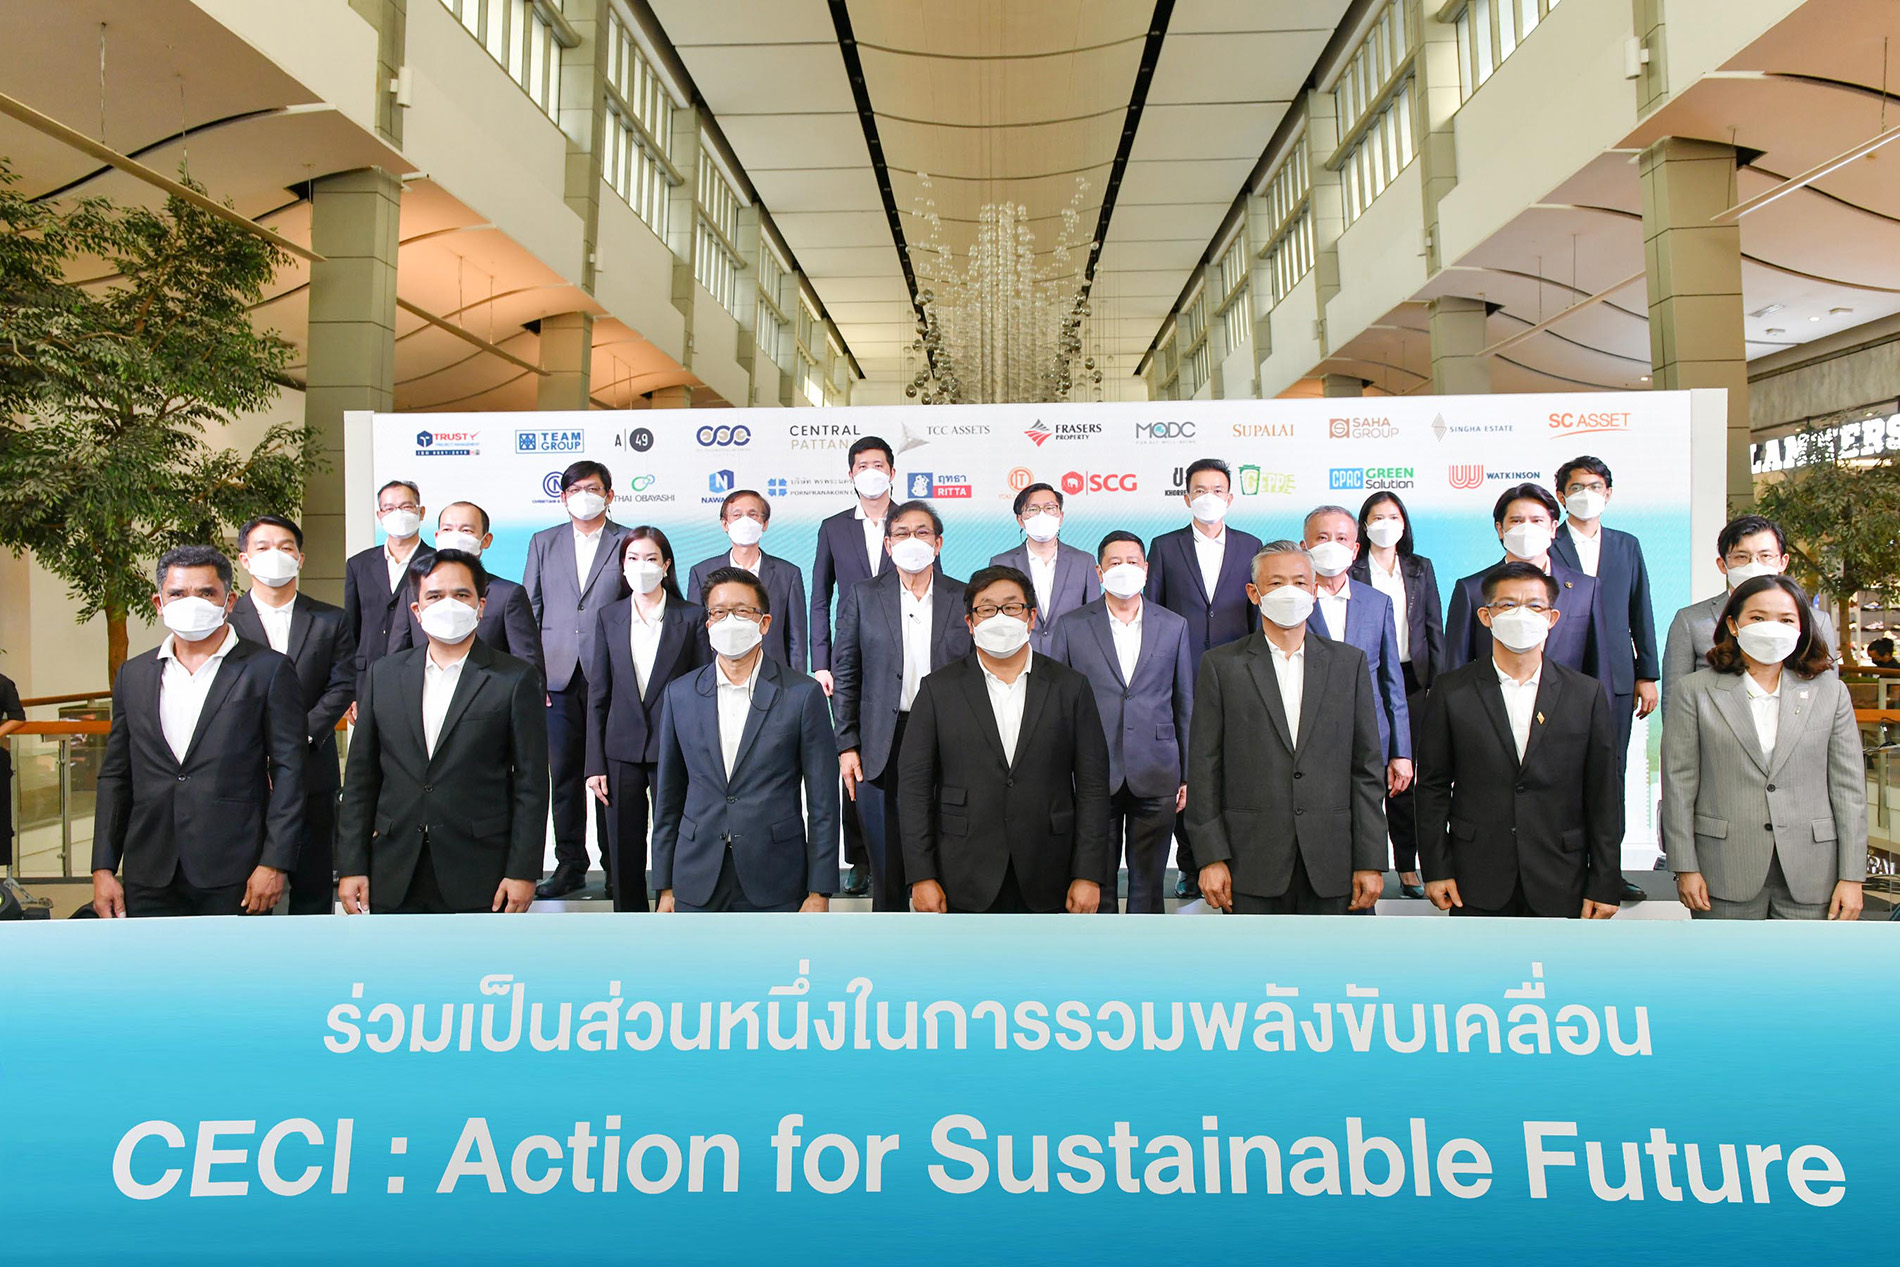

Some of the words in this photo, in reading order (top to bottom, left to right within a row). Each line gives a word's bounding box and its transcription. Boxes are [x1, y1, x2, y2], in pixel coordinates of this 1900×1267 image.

[1353, 417, 1391, 428] SAHA
[1548, 413, 1574, 428] SC
[1576, 412, 1632, 428] ASSET
[789, 424, 861, 437] CENTRAL
[926, 425, 949, 436] TCC
[951, 424, 991, 435] ASSETS
[1055, 423, 1102, 434] FRASERS
[1136, 421, 1196, 439] MQDC
[1232, 424, 1295, 438] SUPALAI
[1352, 427, 1399, 439] GROUP
[1449, 425, 1482, 433] SINGHA
[1484, 424, 1514, 432] ESTATE
[541, 431, 582, 441] TEAM
[634, 433, 649, 447] 49
[541, 441, 581, 451] GROUP
[1331, 470, 1362, 488] CPAC
[1365, 467, 1414, 479] GREEN
[1486, 471, 1541, 480] WATKINSON
[1089, 473, 1138, 493] SCG
[1365, 478, 1414, 490] Solution
[614, 494, 632, 503] THAI
[634, 493, 676, 503] OBAYASHI
[937, 488, 967, 496] RITTA
[323, 959, 1652, 1056] ร่วมเป็นส่วนหนึ่งในการรวมพลังขับเคลื่อน
[112, 1118, 354, 1200] CECI
[388, 1137, 406, 1194] :
[436, 1115, 740, 1195] Action
[771, 1114, 900, 1195] for
[927, 1114, 1493, 1200] Sustainable
[1523, 1121, 1846, 1208] Future
